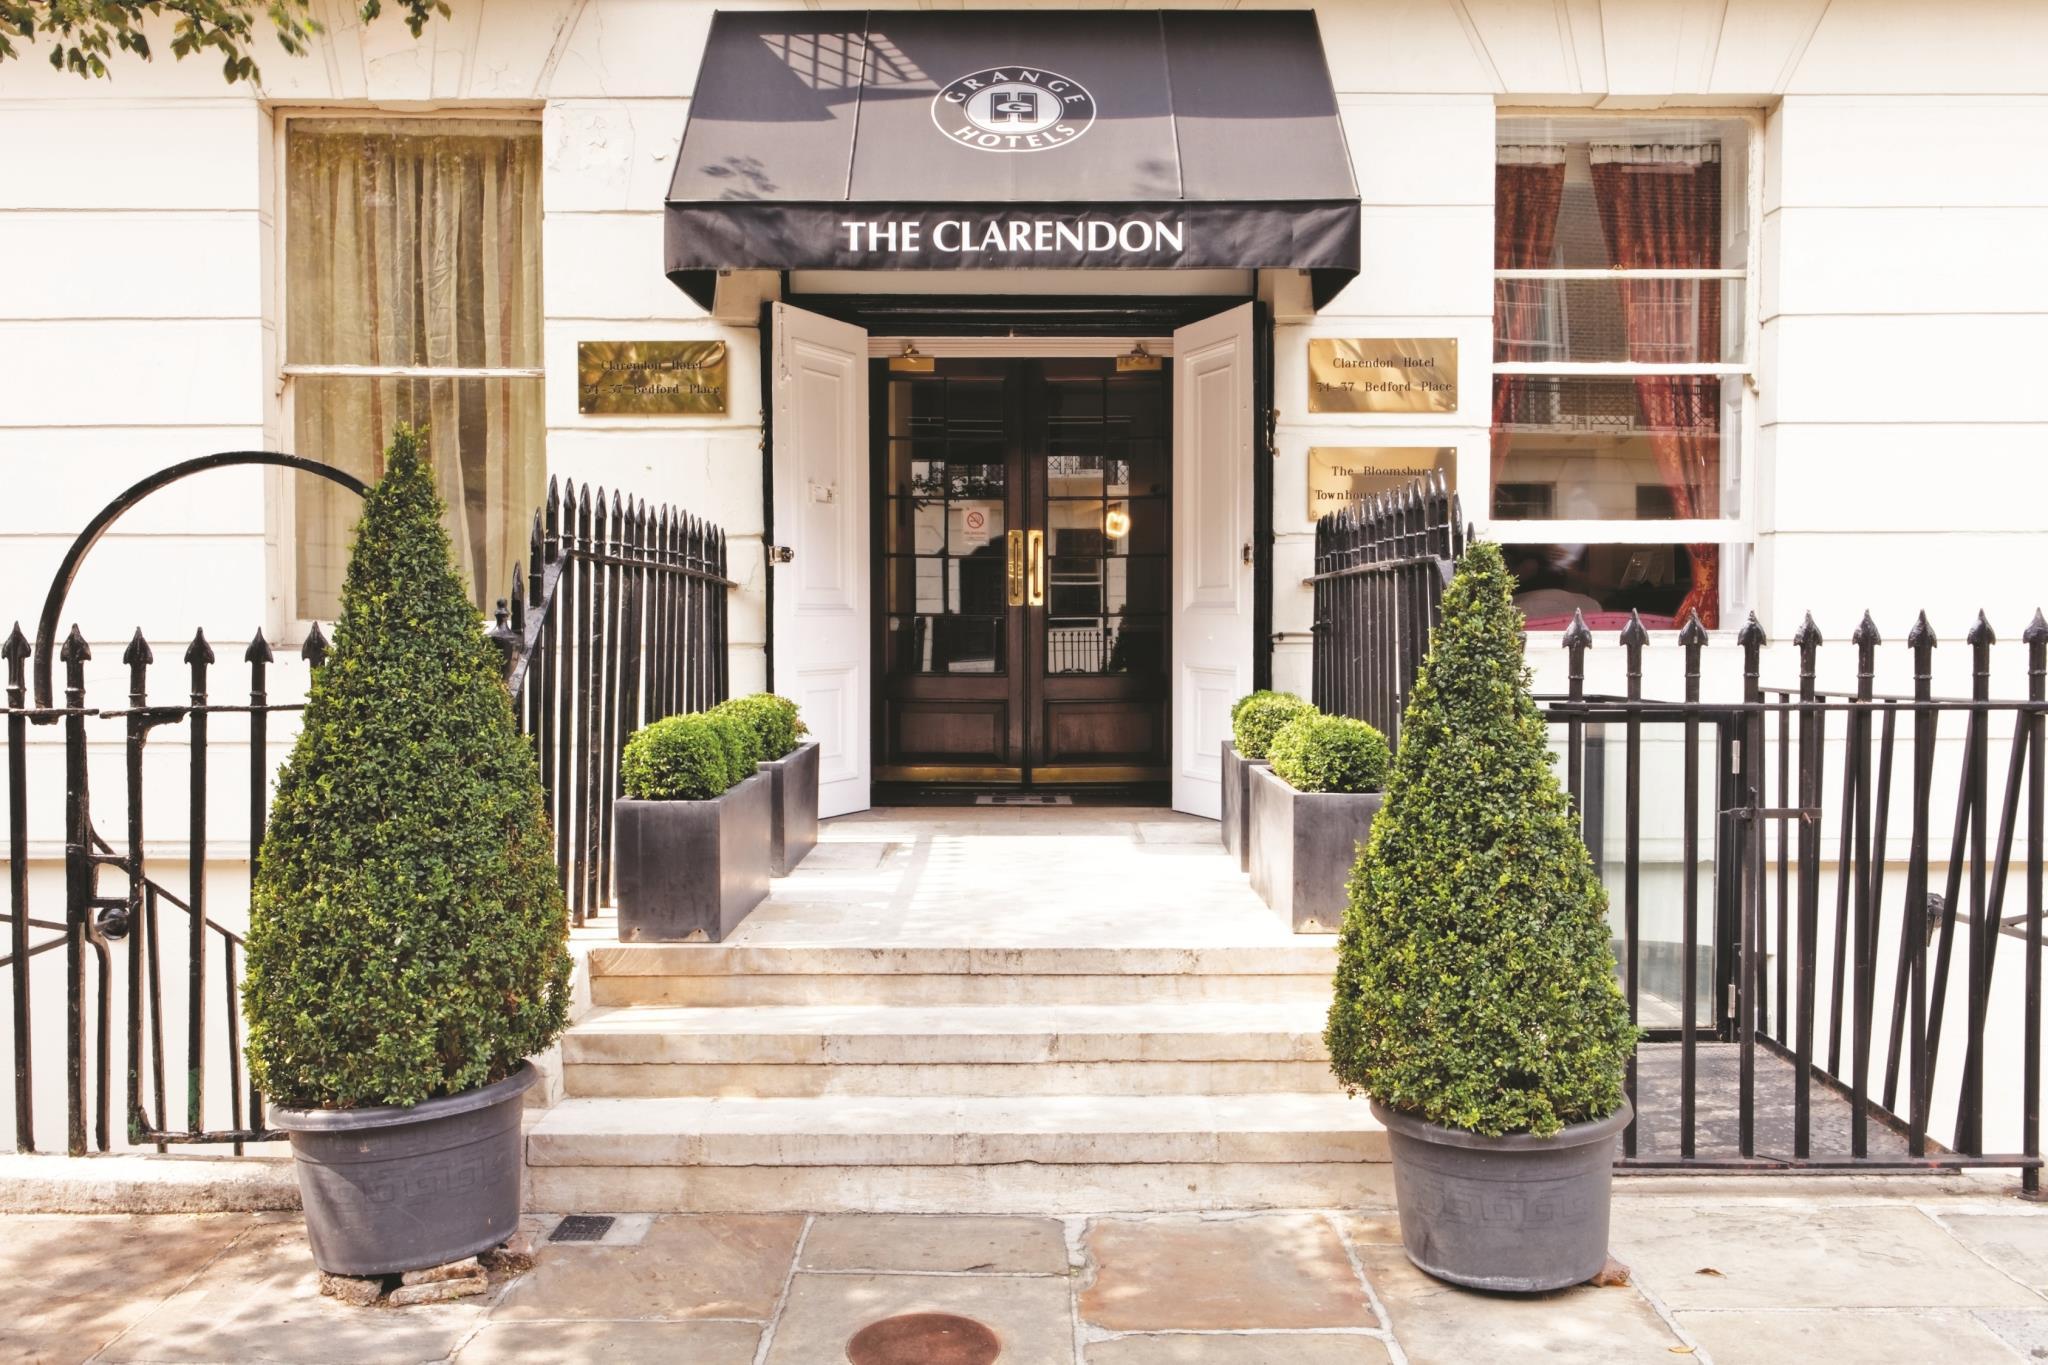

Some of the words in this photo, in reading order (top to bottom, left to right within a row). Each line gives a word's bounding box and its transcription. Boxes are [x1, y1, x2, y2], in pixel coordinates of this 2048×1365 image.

[945, 70, 1085, 104] GRANGE
[954, 124, 1076, 148] HOTELS
[842, 221, 920, 251] THE
[932, 220, 1183, 252] CLARENDON
[600, 360, 662, 370] Clarendon
[671, 360, 703, 370] Hotel
[1333, 357, 1394, 368] Clarendon
[1402, 357, 1435, 368] Hotel
[633, 384, 680, 394] Bedford
[689, 384, 720, 394] Place
[1364, 381, 1411, 392] Bedford
[1421, 381, 1452, 392] Place
[1331, 466, 1354, 476] The
